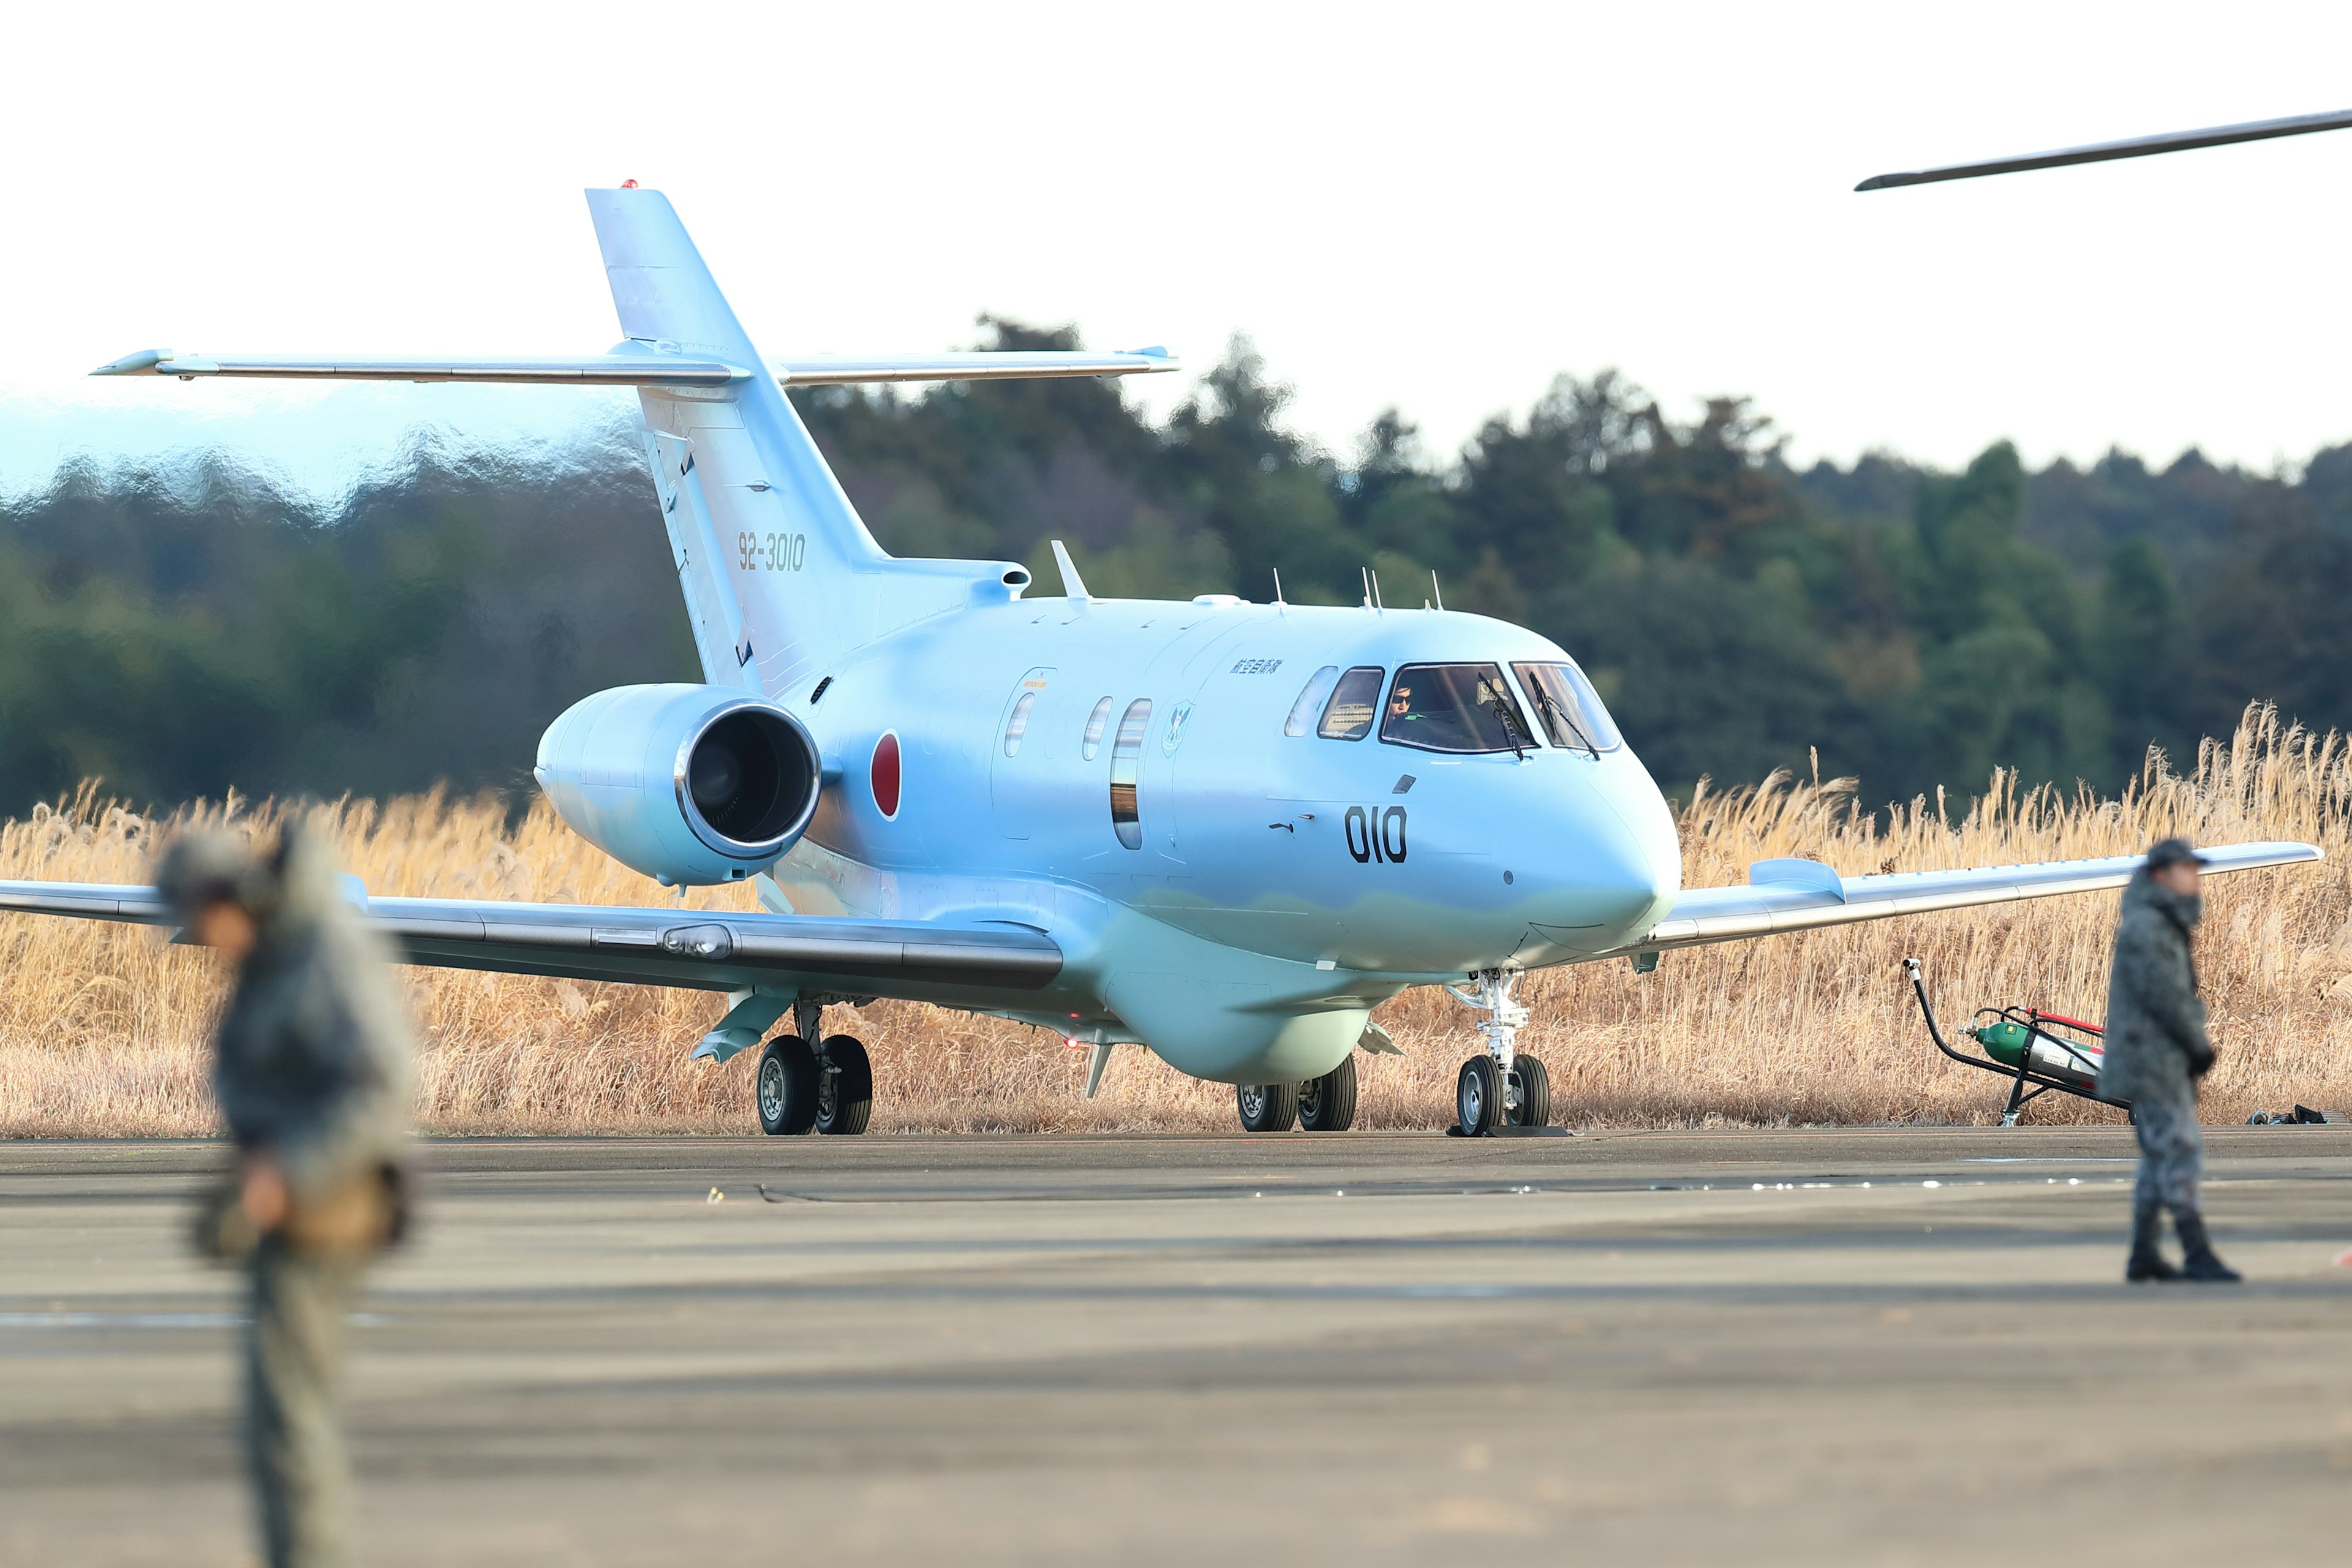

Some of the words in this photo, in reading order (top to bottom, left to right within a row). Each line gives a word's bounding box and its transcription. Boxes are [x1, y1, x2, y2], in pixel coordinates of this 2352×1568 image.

[739, 532, 805, 571] 92-3010
[1229, 658, 1284, 674] 航空自衛隊
[1344, 805, 1408, 864] 010
